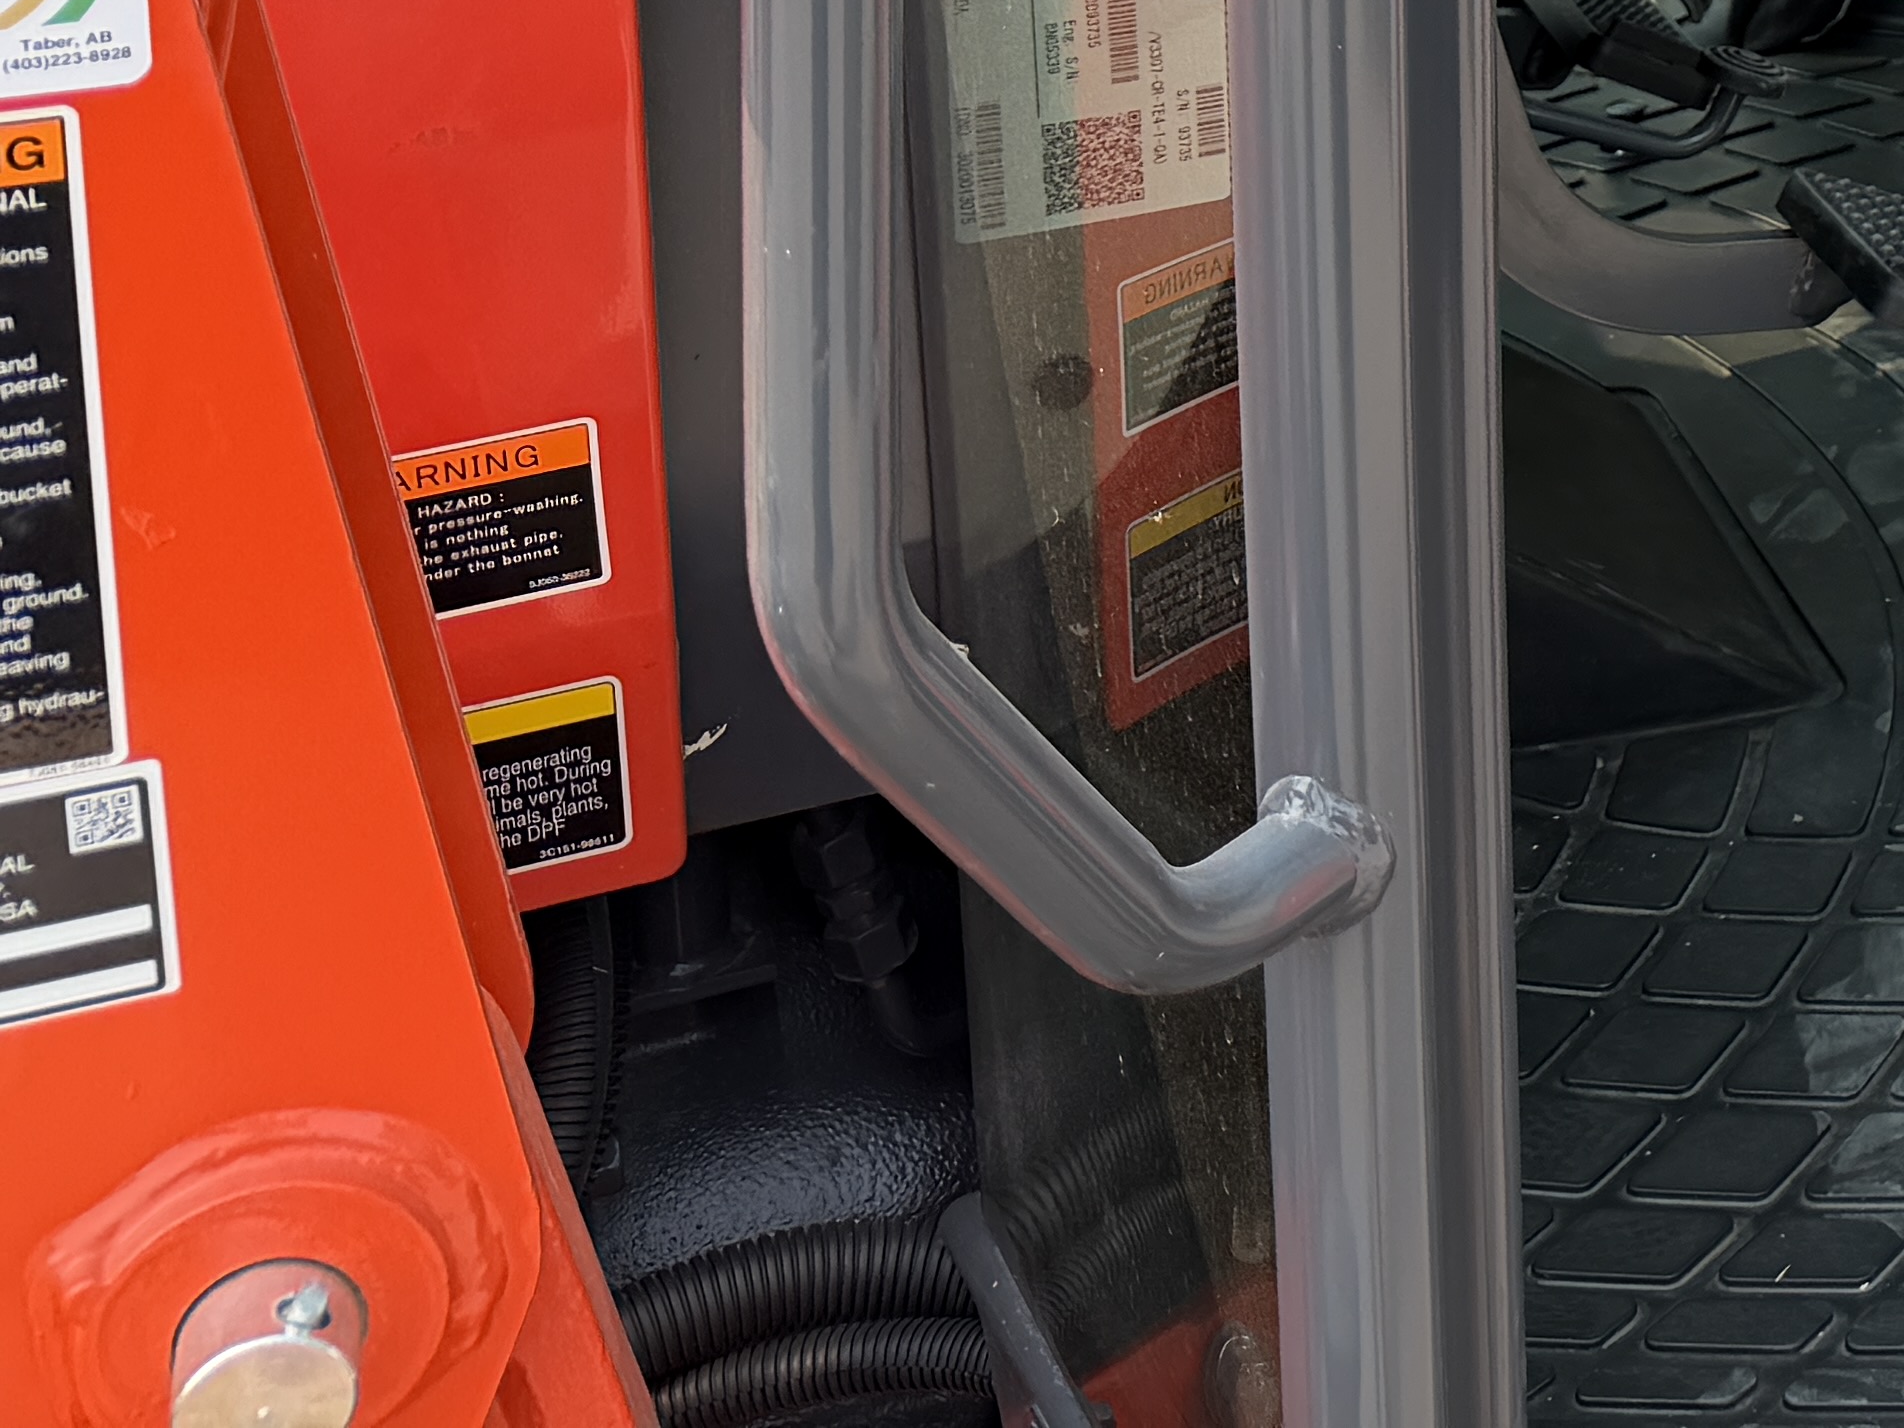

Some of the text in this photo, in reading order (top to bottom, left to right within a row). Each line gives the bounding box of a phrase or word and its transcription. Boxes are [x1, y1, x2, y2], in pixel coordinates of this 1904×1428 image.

[20, 30, 113, 53] Taber, AB
[2, 45, 132, 75] (403)223-8928
[0, 439, 67, 463] cause
[395, 445, 539, 491] ARNING
[417, 493, 492, 519] HAZARD
[424, 524, 509, 551] is nothing
[450, 538, 517, 561] exhaust
[424, 544, 561, 581] nder the bonnet
[2, 582, 90, 615] ground.
[19, 688, 105, 717] hydrau-
[482, 745, 592, 784] regenerating
[516, 770, 549, 794] hot.
[554, 759, 612, 784] During
[501, 777, 598, 814] be very hot
[495, 794, 609, 833] imals, plants,
[527, 819, 566, 842] DPF
